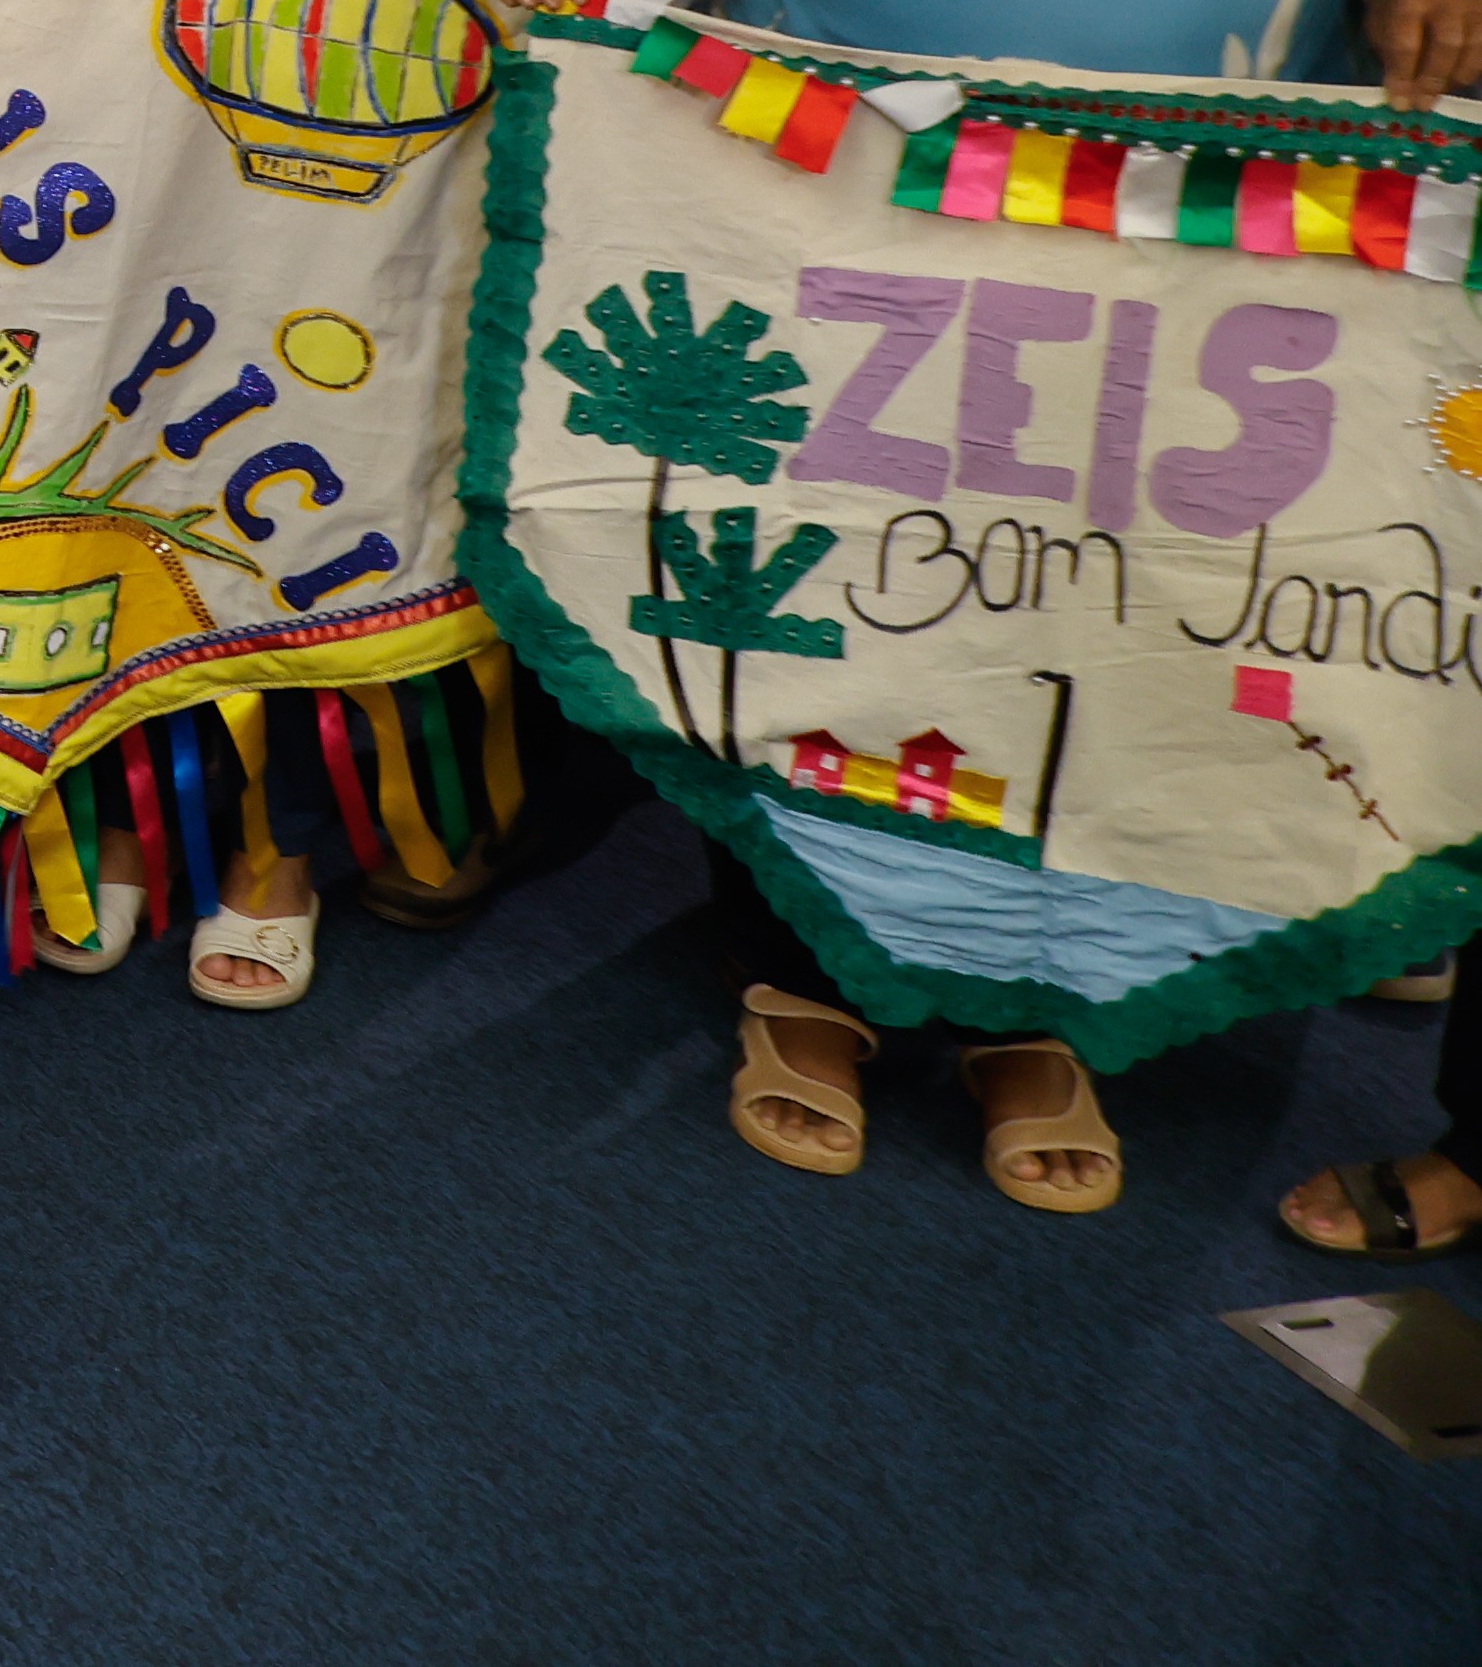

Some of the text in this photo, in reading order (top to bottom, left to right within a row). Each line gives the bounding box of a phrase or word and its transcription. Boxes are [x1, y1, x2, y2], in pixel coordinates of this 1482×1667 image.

[108, 285, 400, 611] PICI
[789, 267, 1336, 533] ZEIS
[846, 508, 1127, 634] Bom
